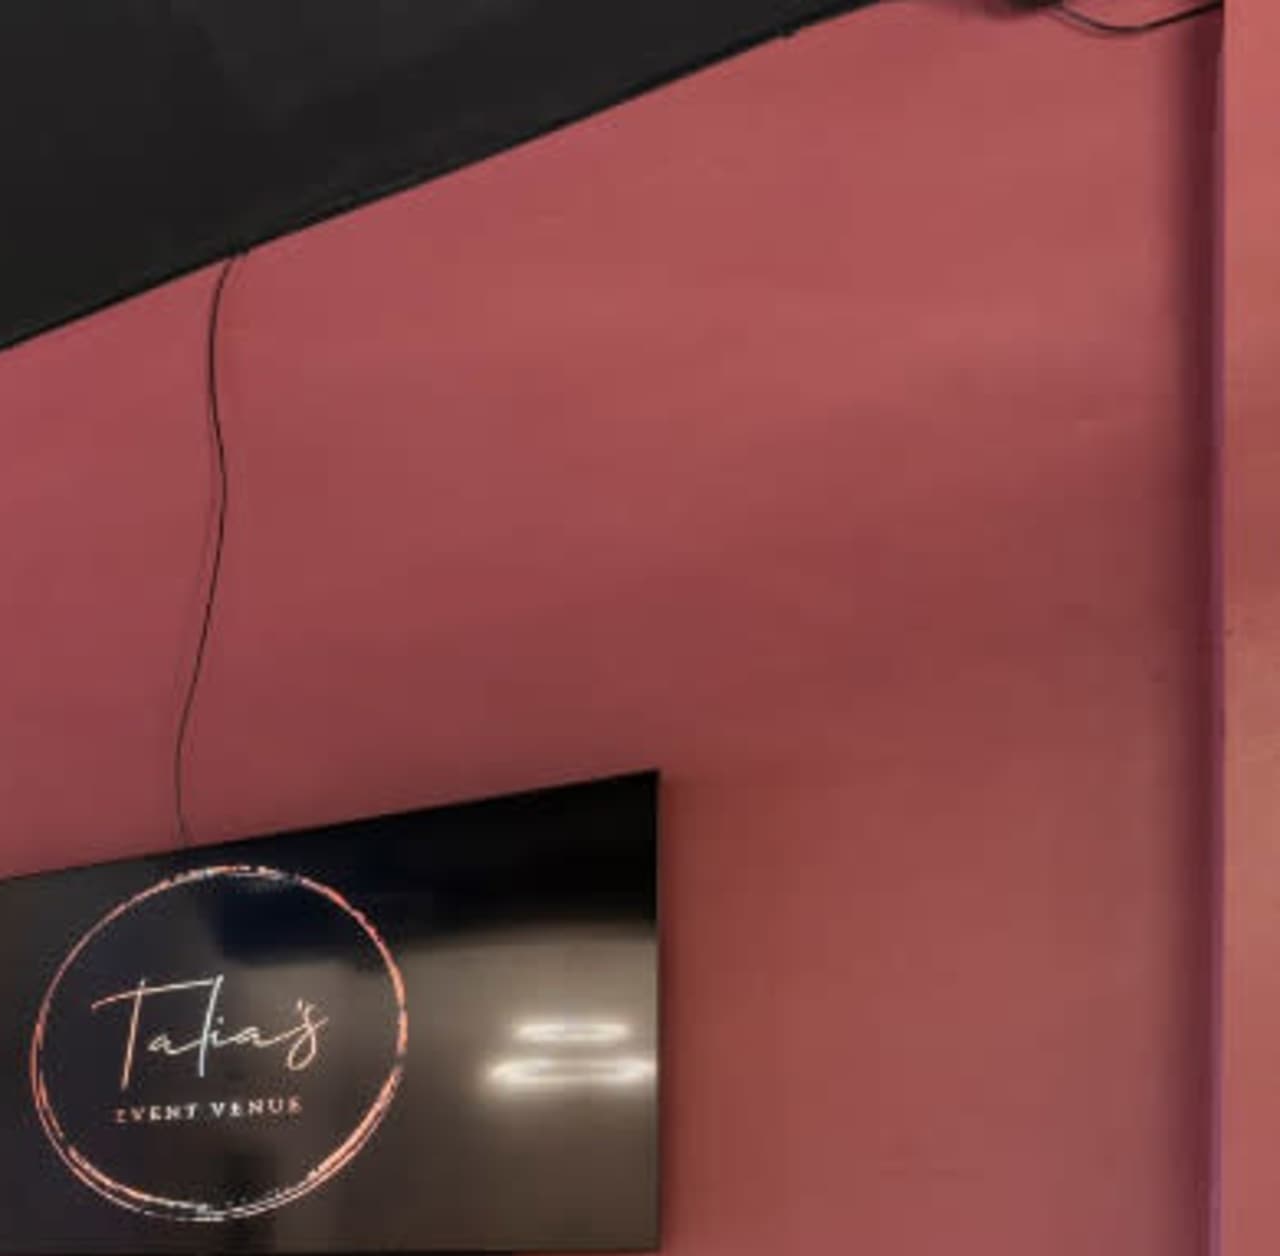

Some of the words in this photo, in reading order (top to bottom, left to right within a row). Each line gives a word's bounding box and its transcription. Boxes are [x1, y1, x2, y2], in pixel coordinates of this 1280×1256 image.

[90, 973, 329, 1091] Talia's
[113, 1102, 199, 1124] EVENT
[209, 1096, 303, 1119] VENUE
